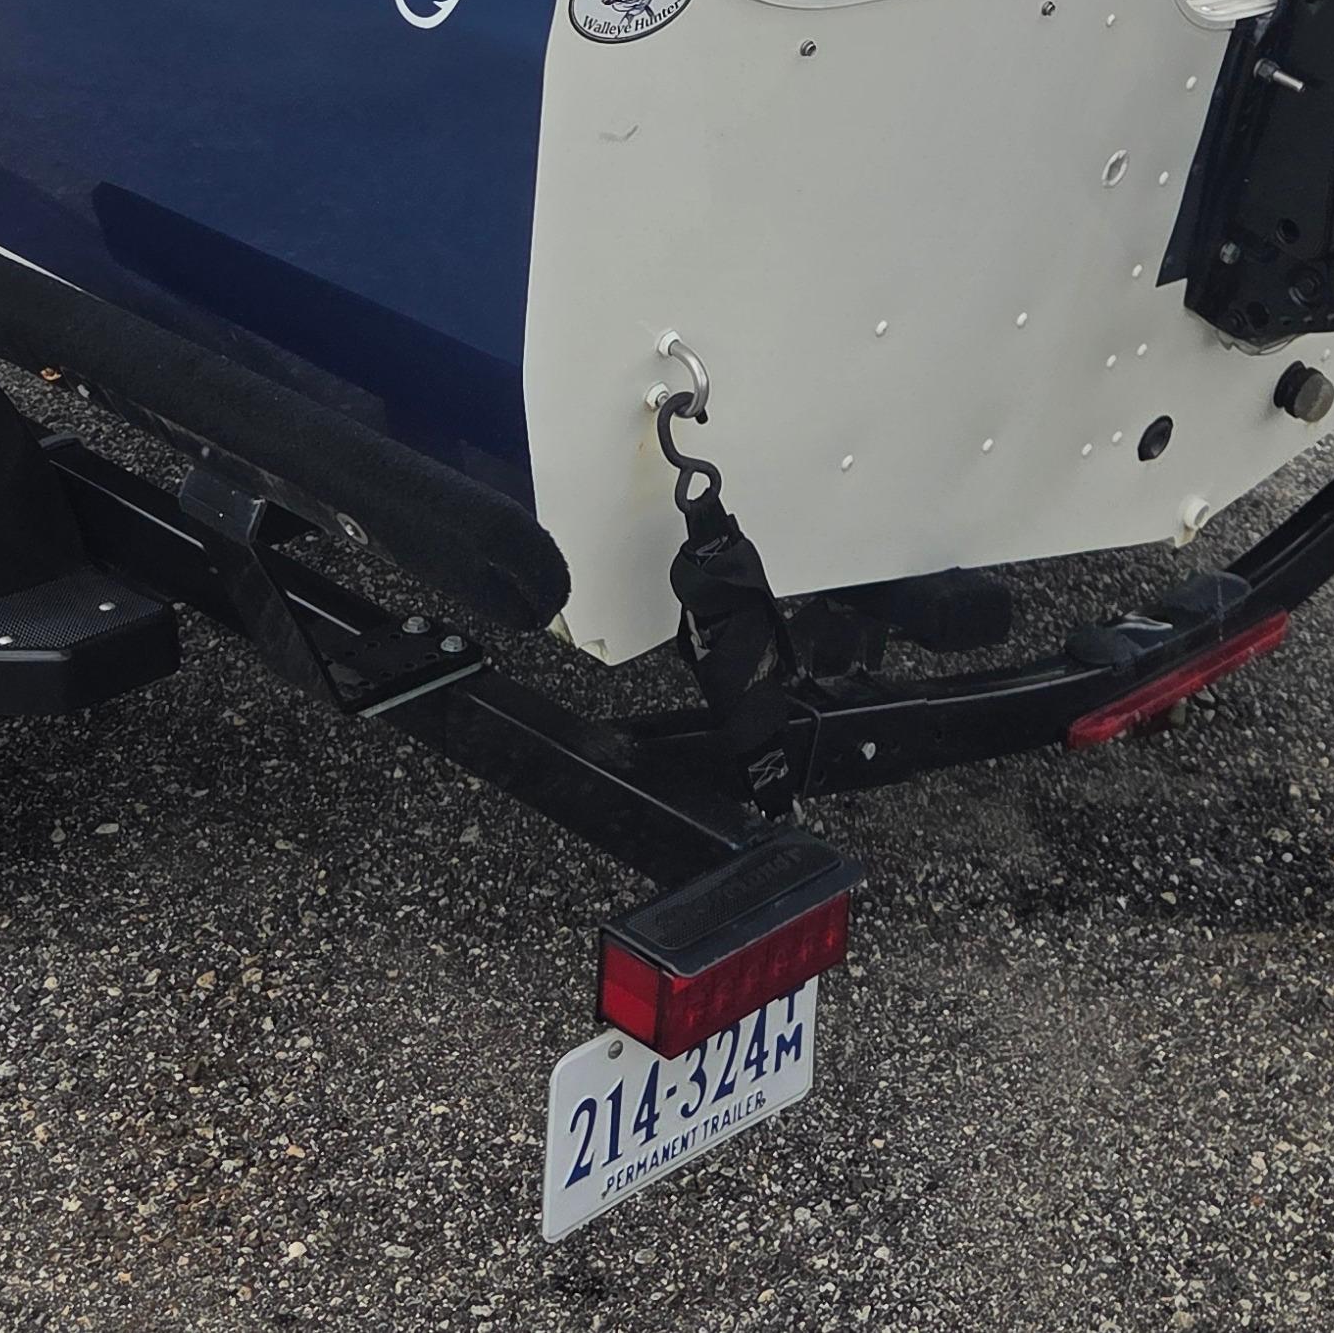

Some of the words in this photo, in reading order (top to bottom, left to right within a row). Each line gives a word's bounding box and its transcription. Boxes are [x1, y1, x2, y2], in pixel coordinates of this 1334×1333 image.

[583, 15, 632, 37] Walleye
[635, 0, 681, 32] Hunter
[605, 1126, 699, 1193] PERMANENT
[702, 1089, 764, 1140] TRAILER
